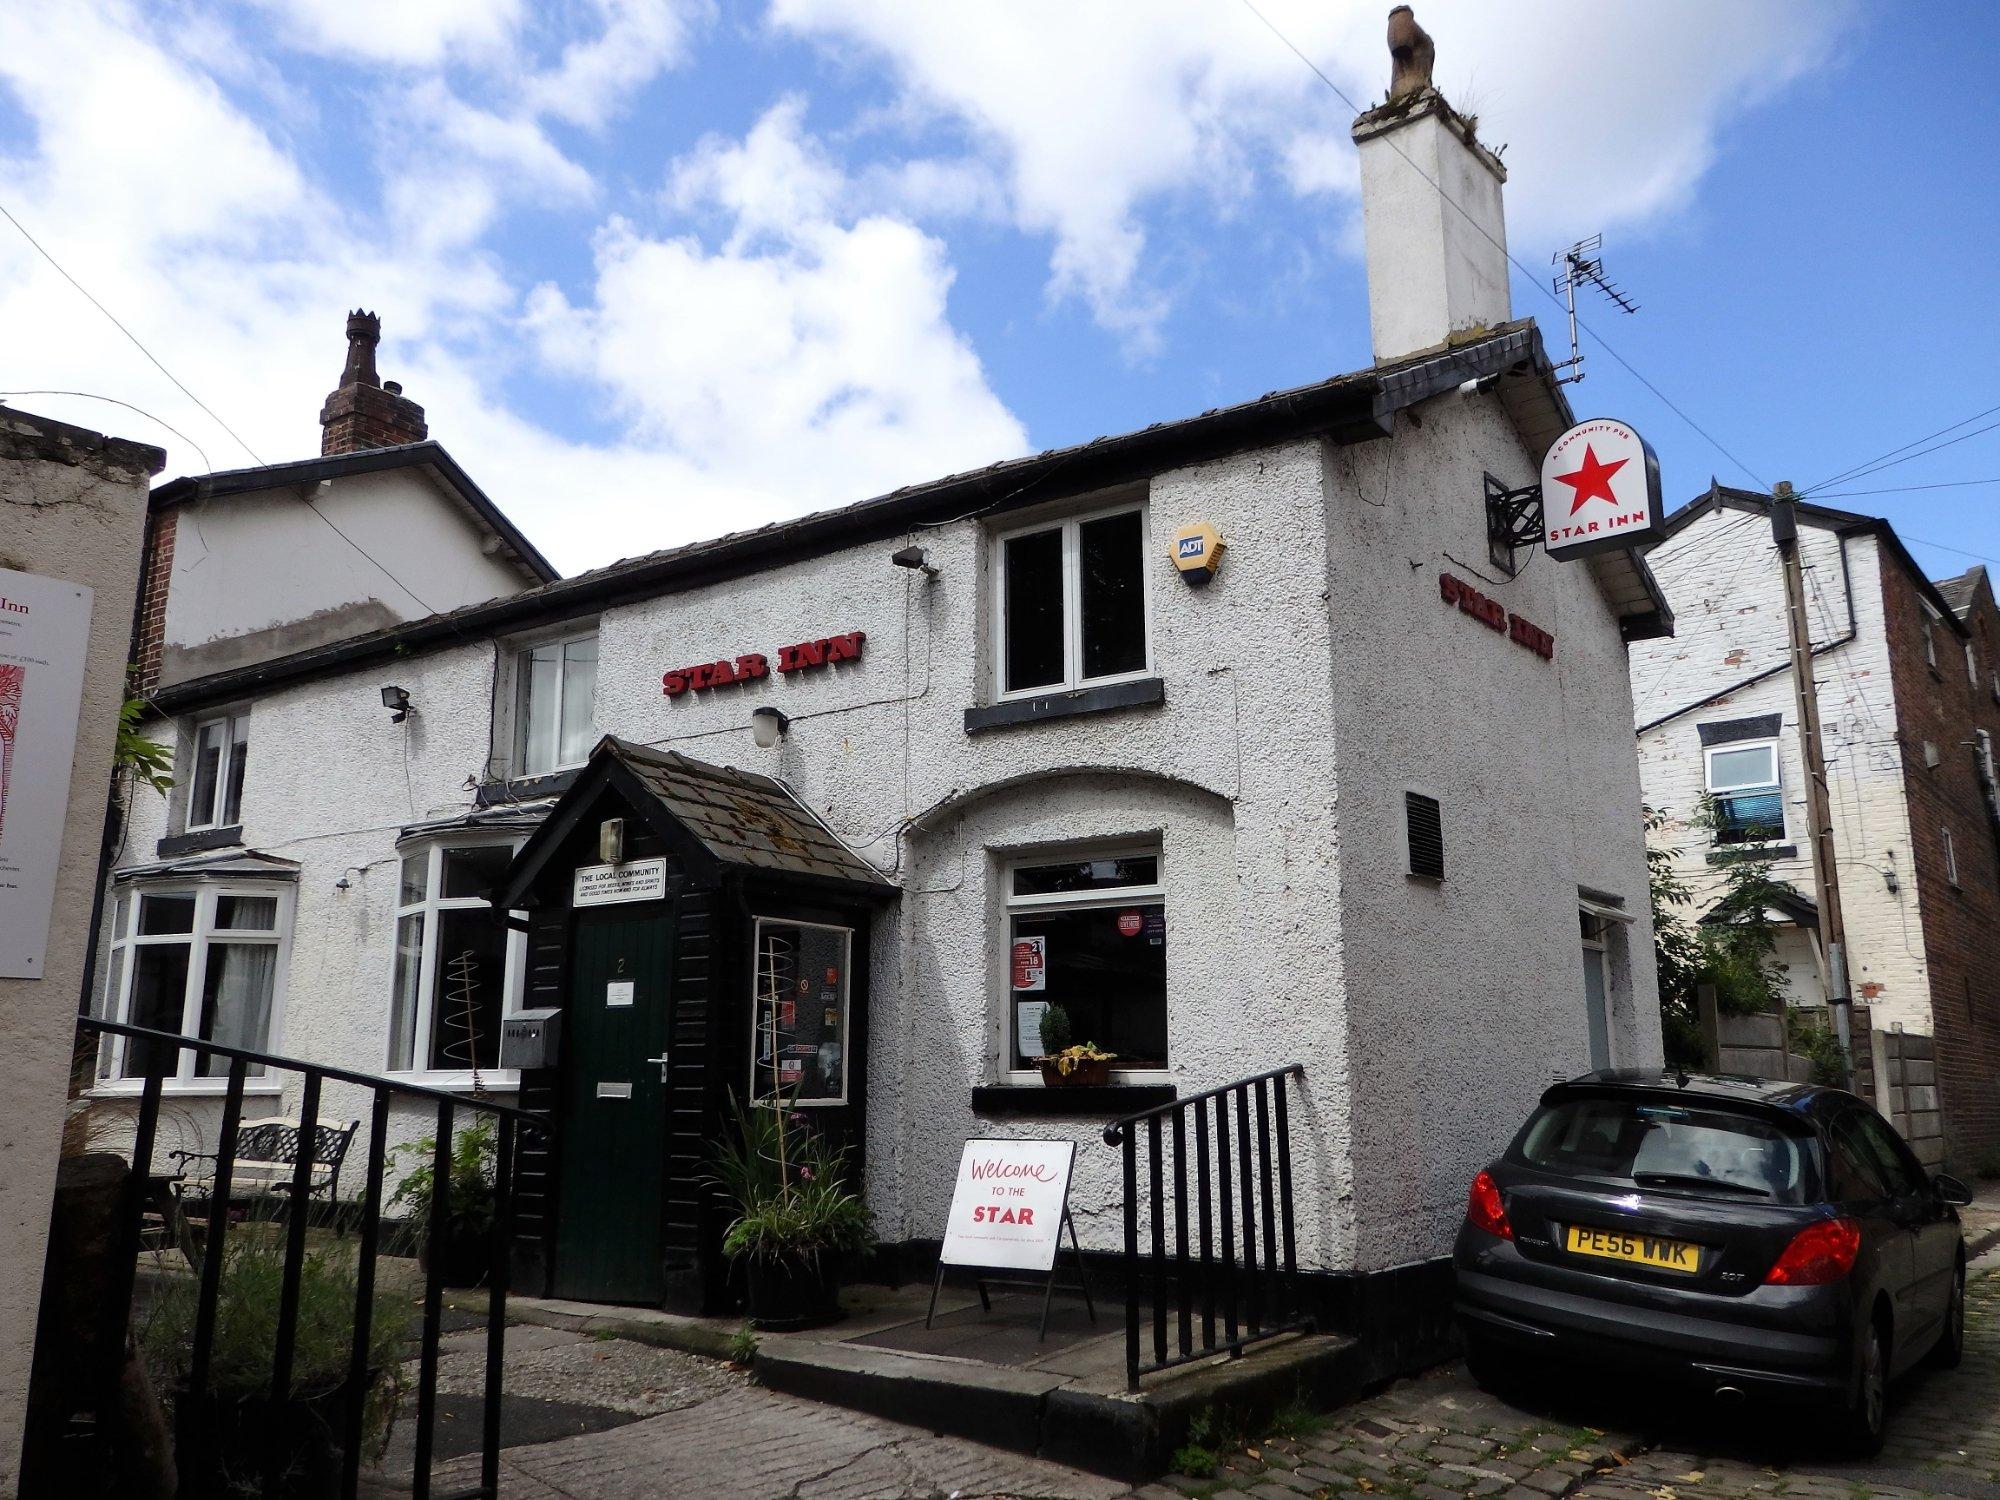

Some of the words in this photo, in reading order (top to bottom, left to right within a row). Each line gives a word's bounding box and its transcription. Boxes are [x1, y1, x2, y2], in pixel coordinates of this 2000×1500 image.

[1557, 425, 1611, 452] COMMUNITY
[1613, 428, 1630, 440] PUB
[1550, 521, 1599, 541] STAR
[1608, 510, 1645, 529] INN
[1180, 541, 1204, 555] ADT
[0, 597, 29, 614] Inn
[1439, 573, 1507, 634] STAR
[1508, 613, 1555, 661] INN
[663, 653, 770, 696] STAR
[777, 631, 866, 673] INN
[581, 875, 594, 883] THE
[595, 872, 617, 881] LOCAL
[618, 867, 660, 879] COMMUNITY
[1031, 941, 1042, 952] 21
[617, 958, 625, 974] 2
[1029, 956, 1039, 965] 18
[971, 1158, 1058, 1182] Welcome
[991, 1186, 1005, 1196] TO
[1008, 1187, 1025, 1197] THE
[973, 1206, 1034, 1226] STAR
[1577, 1228, 1635, 1256] PE56
[1643, 1239, 1687, 1266] WWK
